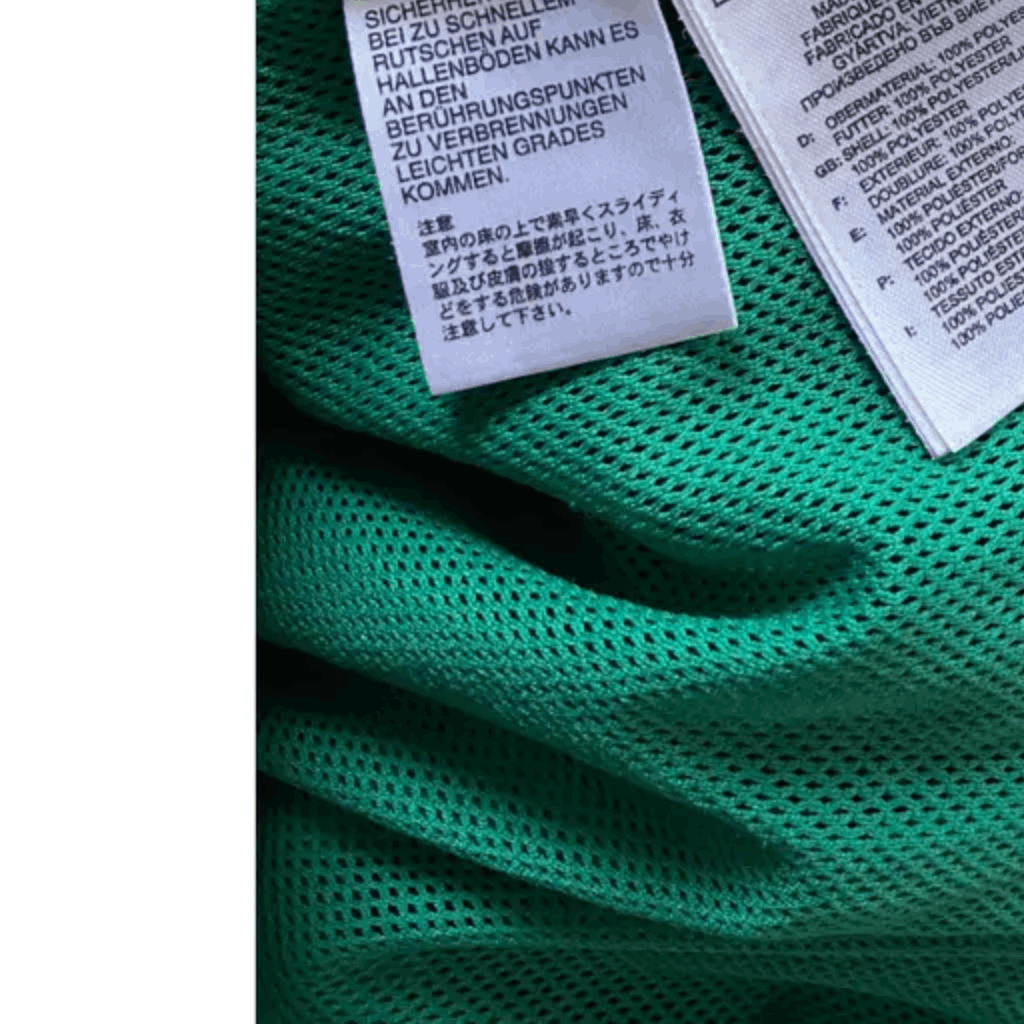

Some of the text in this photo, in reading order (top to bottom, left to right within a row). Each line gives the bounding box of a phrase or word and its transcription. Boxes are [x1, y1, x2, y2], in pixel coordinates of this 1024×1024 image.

[367, 26, 406, 52] BEI
[409, 18, 441, 43] ZU
[371, 18, 542, 73] RUTSCHEN AUF
[375, 20, 640, 96] HALLENBÖDEN KANN ES
[803, 5, 897, 67] FABRICADO
[382, 81, 469, 118] AN DEN
[385, 65, 646, 140] BERÜHRUNGSPUNKTEN
[796, 132, 816, 149] D:
[824, 59, 937, 131] OBERMATERIAL:
[936, 36, 975, 65] 100%
[832, 34, 1013, 147] FUTTER: 100% POLYESTER
[389, 91, 629, 162] ZU VERBRENNUNGEN
[395, 119, 606, 184] LEICHTEN GRADES
[813, 157, 843, 179] GB:
[841, 125, 893, 163] SHELL:
[891, 102, 929, 131] 100%
[851, 98, 971, 176] 100% POLYESTER
[400, 165, 510, 205] KOMMEN.
[831, 195, 849, 212] F:
[942, 114, 979, 142] 100%
[848, 135, 1017, 244] E: MATERIAL EXTERNO:
[867, 153, 949, 210] DOUBLURE:
[948, 131, 986, 159] 100%
[417, 214, 456, 237] 注意
[886, 210, 924, 240] 100%
[895, 178, 1009, 255] 100% POLIÉSTER
[876, 274, 895, 291] P:
[902, 230, 957, 271] TECIDO
[913, 257, 952, 287] 100%
[923, 272, 960, 303] 100%
[903, 325, 918, 339] I:
[929, 269, 995, 319] TESSUTO
[941, 303, 978, 334] 100%
[950, 319, 988, 350] 100%
